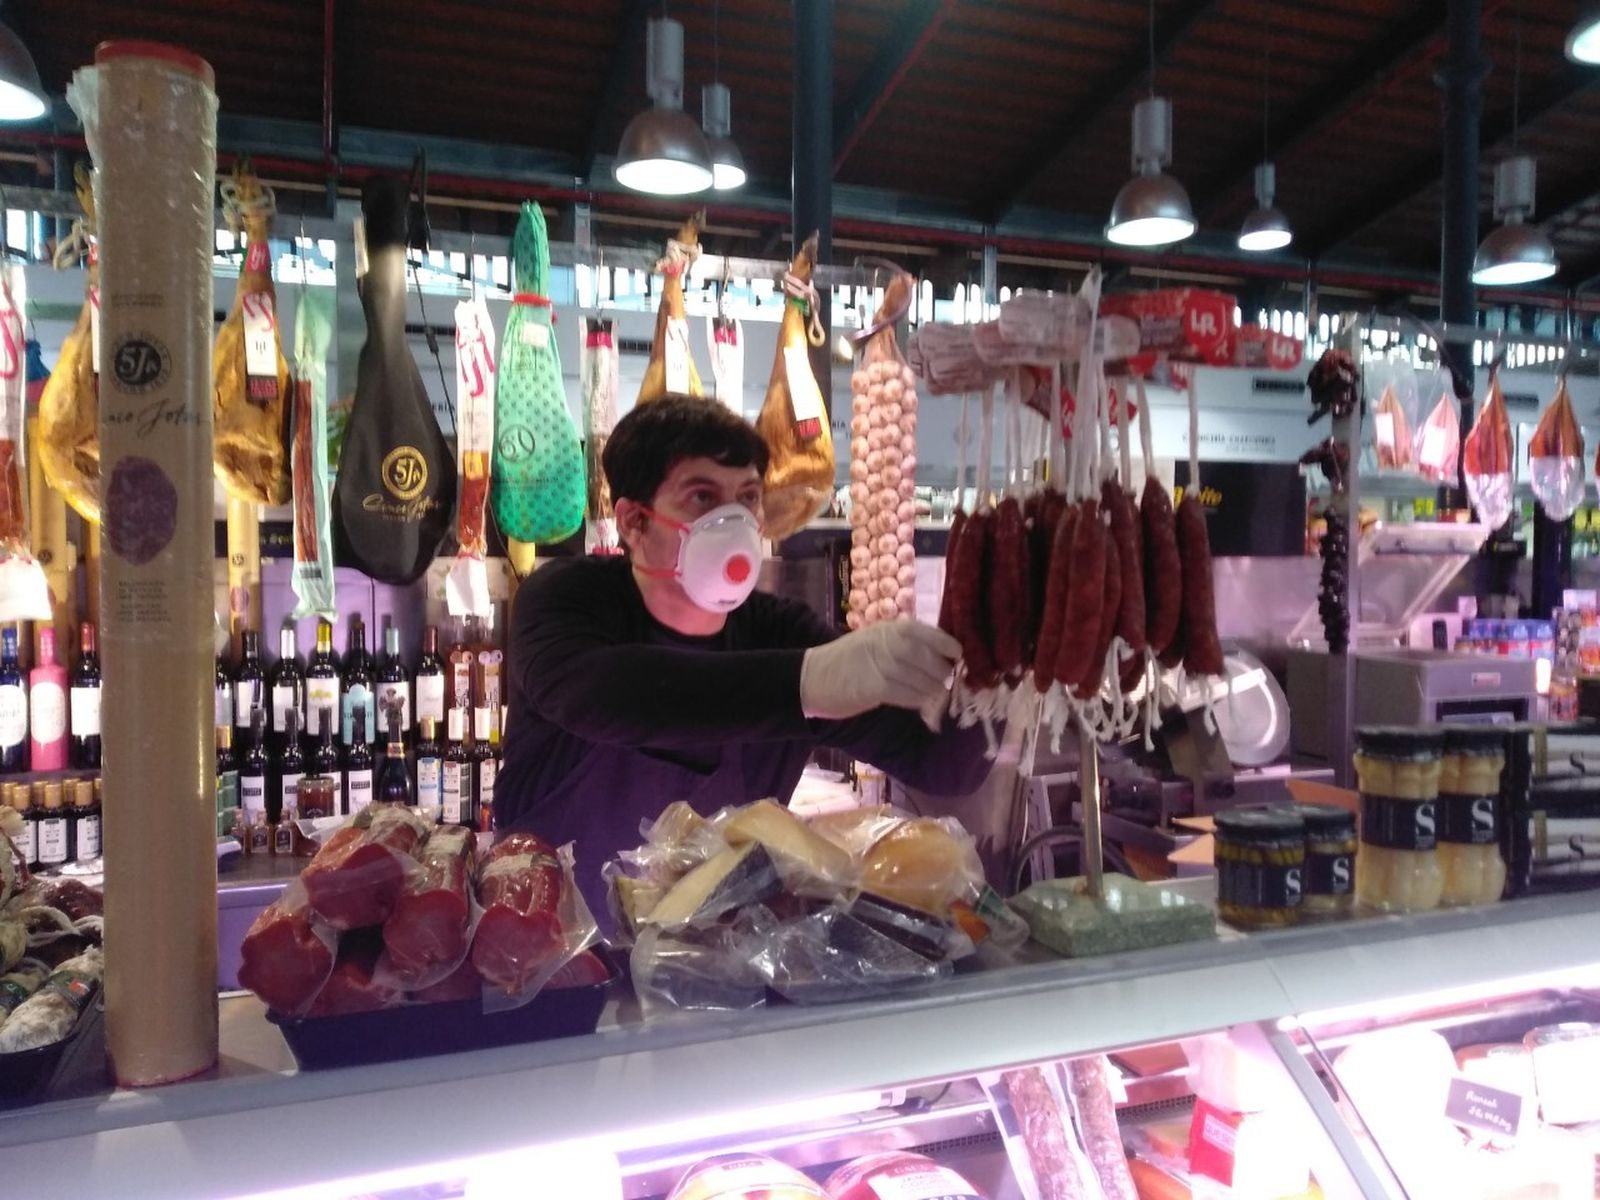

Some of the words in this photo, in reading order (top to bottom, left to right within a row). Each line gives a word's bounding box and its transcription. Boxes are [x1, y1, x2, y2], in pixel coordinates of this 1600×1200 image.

[1570, 751, 1586, 775] S
[1415, 804, 1435, 835] S
[1472, 799, 1494, 830] S
[1569, 834, 1585, 858] S
[1285, 868, 1301, 894] S
[1333, 857, 1349, 884] S
